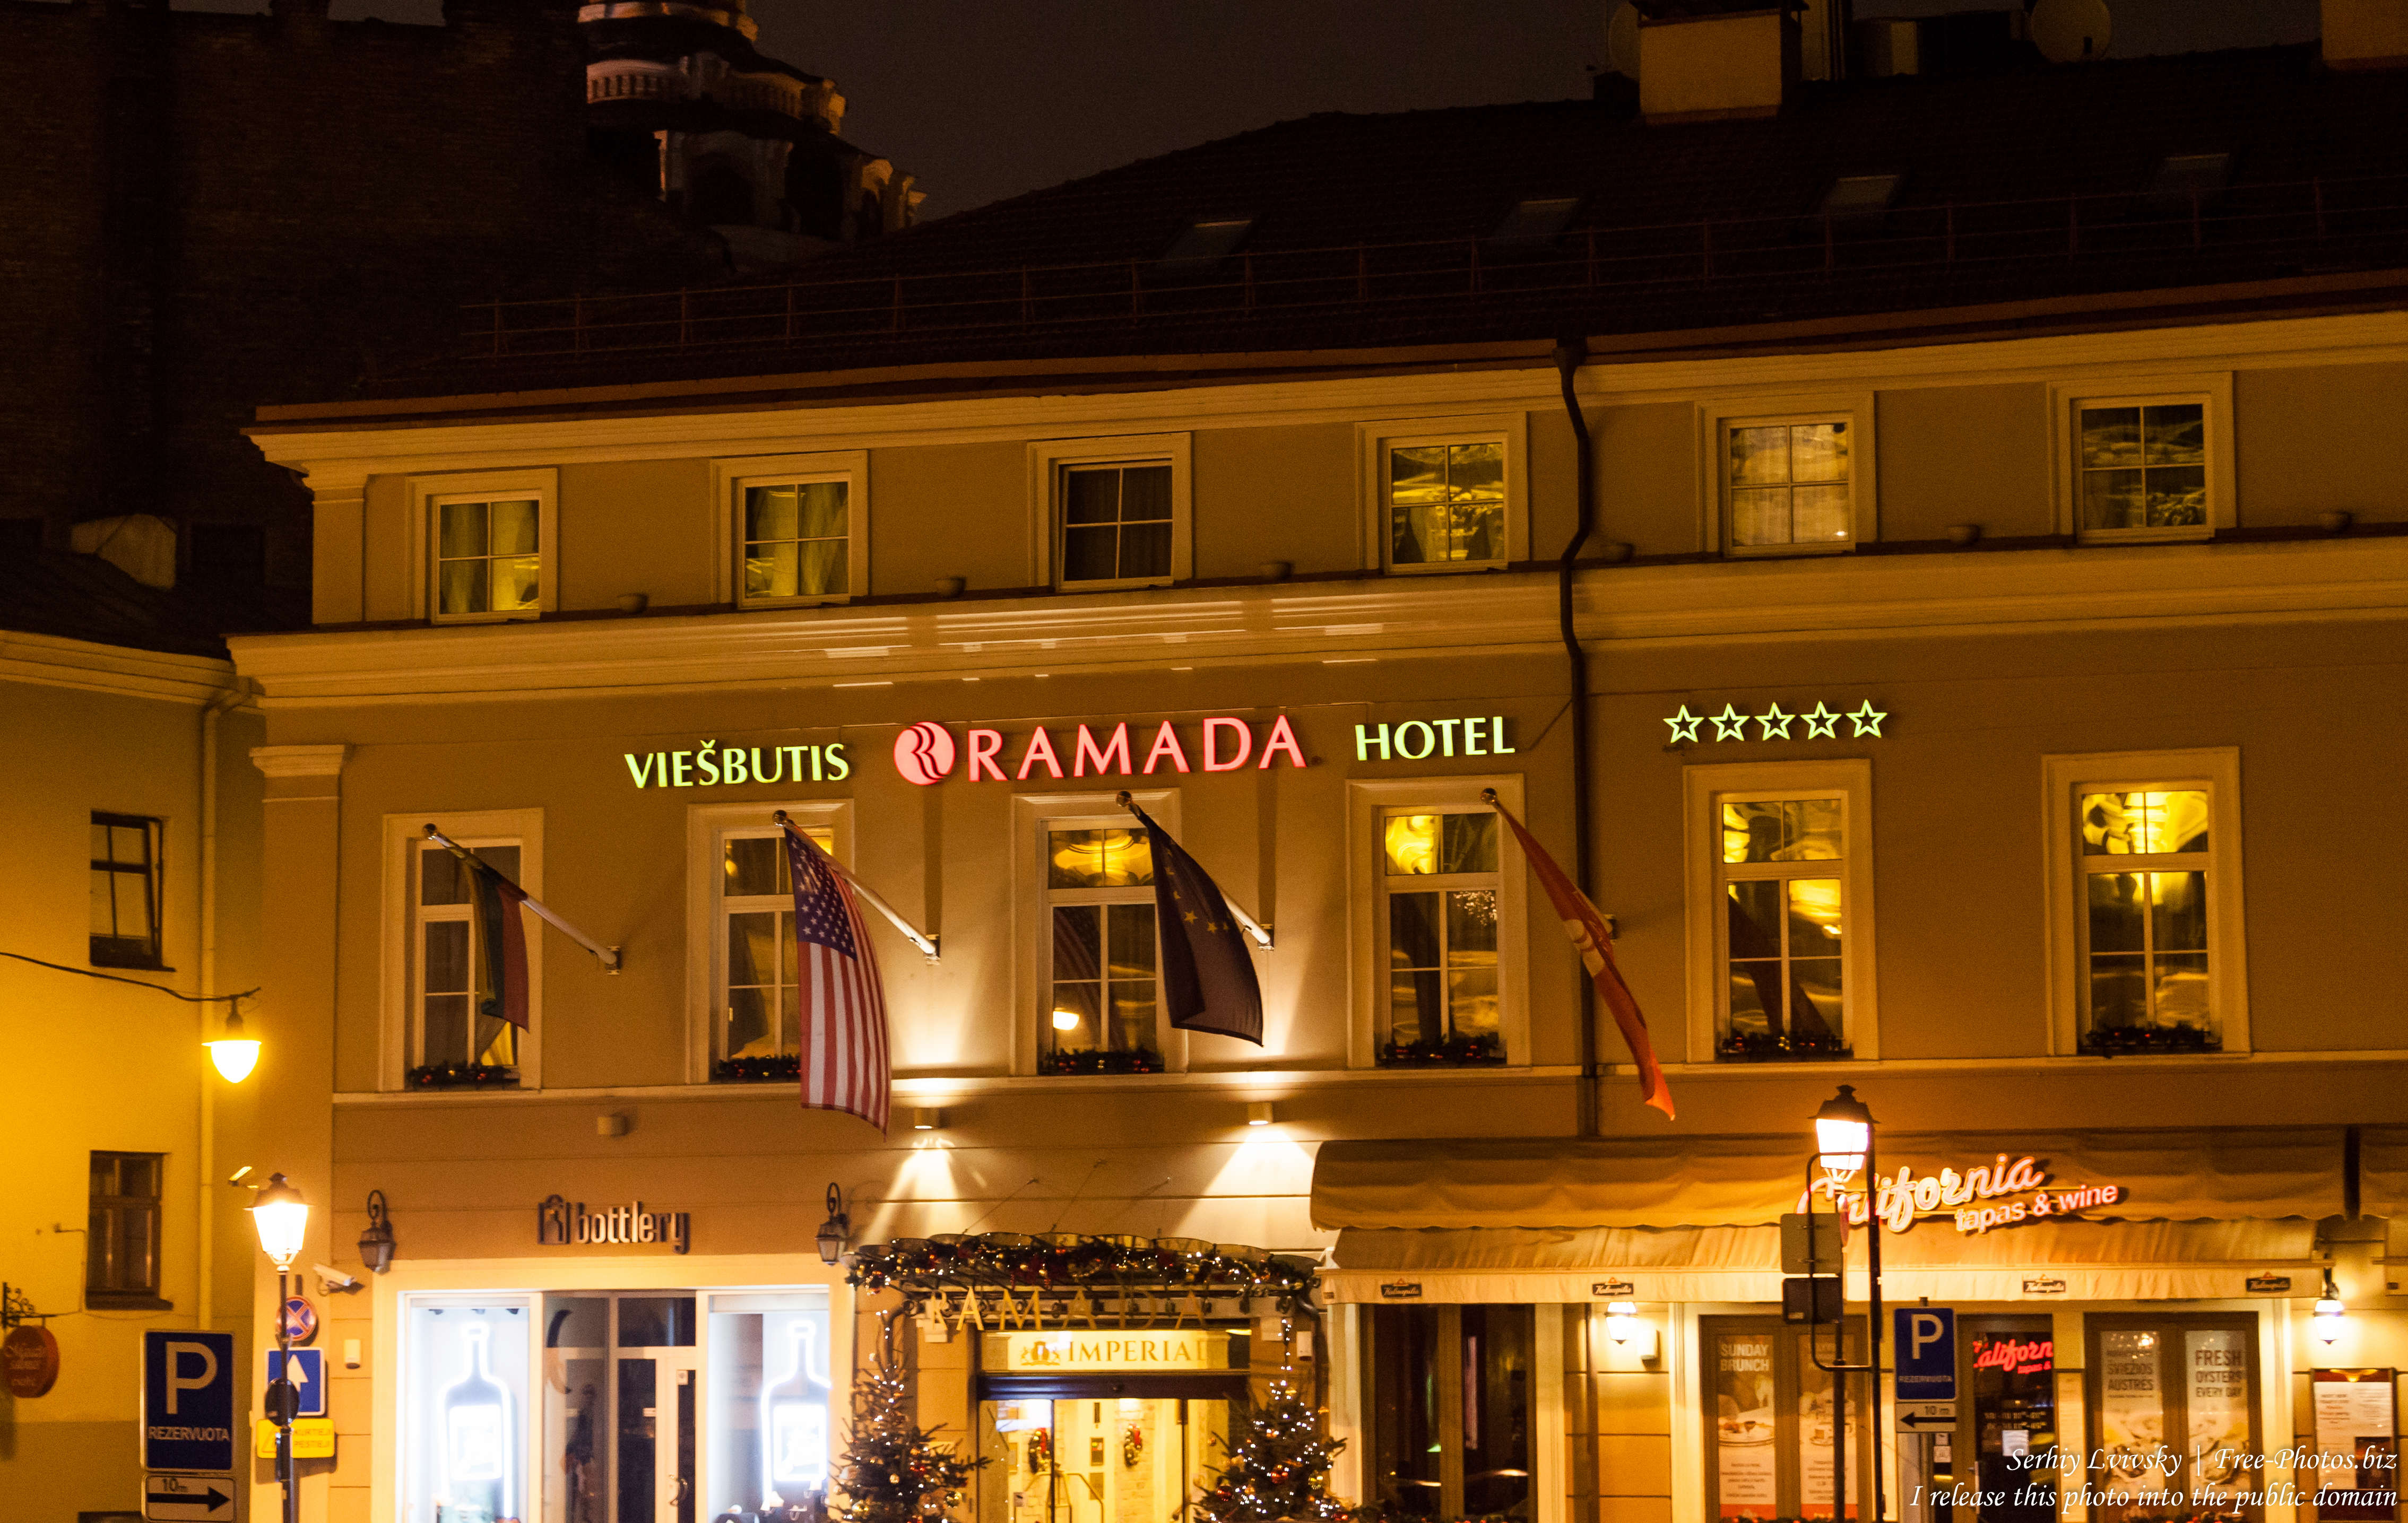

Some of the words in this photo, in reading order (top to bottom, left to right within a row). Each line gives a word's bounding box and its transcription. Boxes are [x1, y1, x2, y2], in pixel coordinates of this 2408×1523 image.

[624, 739, 849, 788] VIEŠBUTIS
[968, 715, 1306, 782] RAMADA
[1355, 716, 1515, 761] HOTEL
[1955, 1202, 2027, 1233] tapas
[2033, 1193, 2053, 1216] &
[2058, 1184, 2119, 1211] wine
[575, 1200, 690, 1255] bottlery
[931, 1287, 1206, 1330] RAMADA
[1912, 1313, 1944, 1360] P
[1069, 1339, 1207, 1362] IMPERIAL
[1721, 1344, 1769, 1356] SUNDAY
[2195, 1350, 2242, 1366] FRESH
[1721, 1358, 1770, 1372] BRUNCH
[2196, 1370, 2242, 1383] OYSTERS
[166, 1341, 218, 1415] P
[2196, 1387, 2222, 1397] EVERY
[148, 1426, 230, 1441] REZERVUOTA
